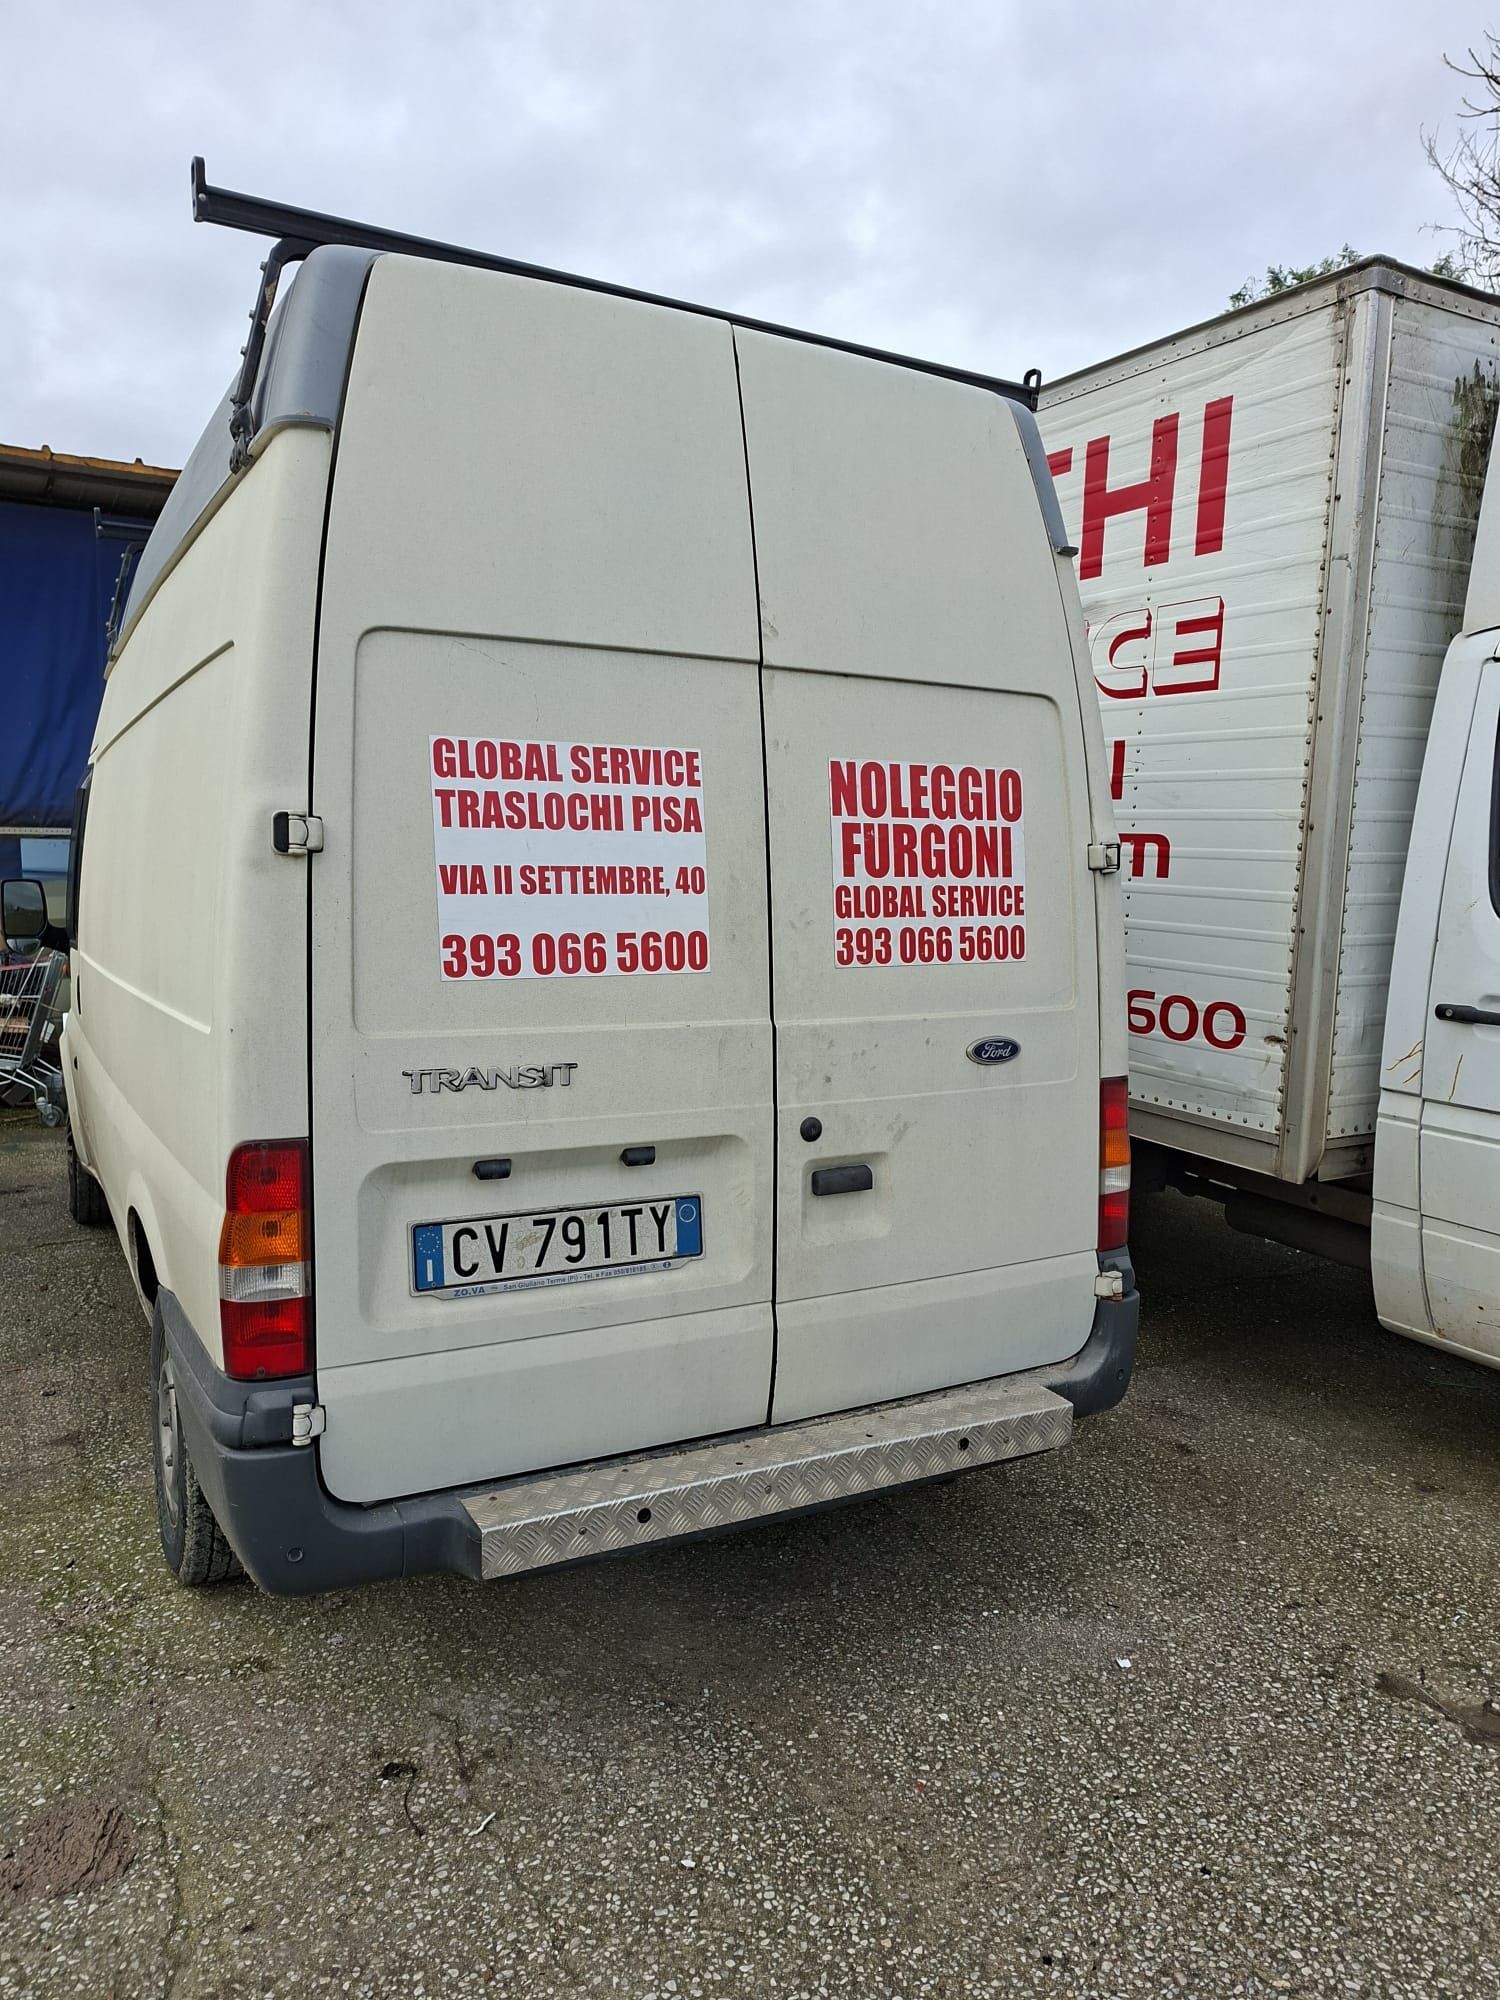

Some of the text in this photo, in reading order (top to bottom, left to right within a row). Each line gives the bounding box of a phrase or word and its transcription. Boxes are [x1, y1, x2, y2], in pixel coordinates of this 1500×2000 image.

[1047, 394, 1234, 581] HI
[1085, 595, 1225, 700] CE
[433, 738, 701, 787] GLOBAL SERVICE
[435, 789, 703, 832] TRASLOCHI PISA
[830, 761, 1023, 823] NOLEGGIO
[842, 823, 1013, 878] FURGONI
[439, 865, 488, 895] VIA
[519, 865, 671, 898] SETTEMBRE,
[675, 867, 705, 895] 40
[835, 885, 1025, 918] GLOBAL SERVICE
[442, 931, 709, 978] 393 066 5600
[836, 925, 1025, 965] 393 066 5600
[1128, 989, 1247, 1050] 600
[981, 1042, 1012, 1058] Ford
[402, 1063, 578, 1094] TRANSIT
[452, 1205, 671, 1278] CV 791TY
[453, 1286, 485, 1297] ZO.VA
